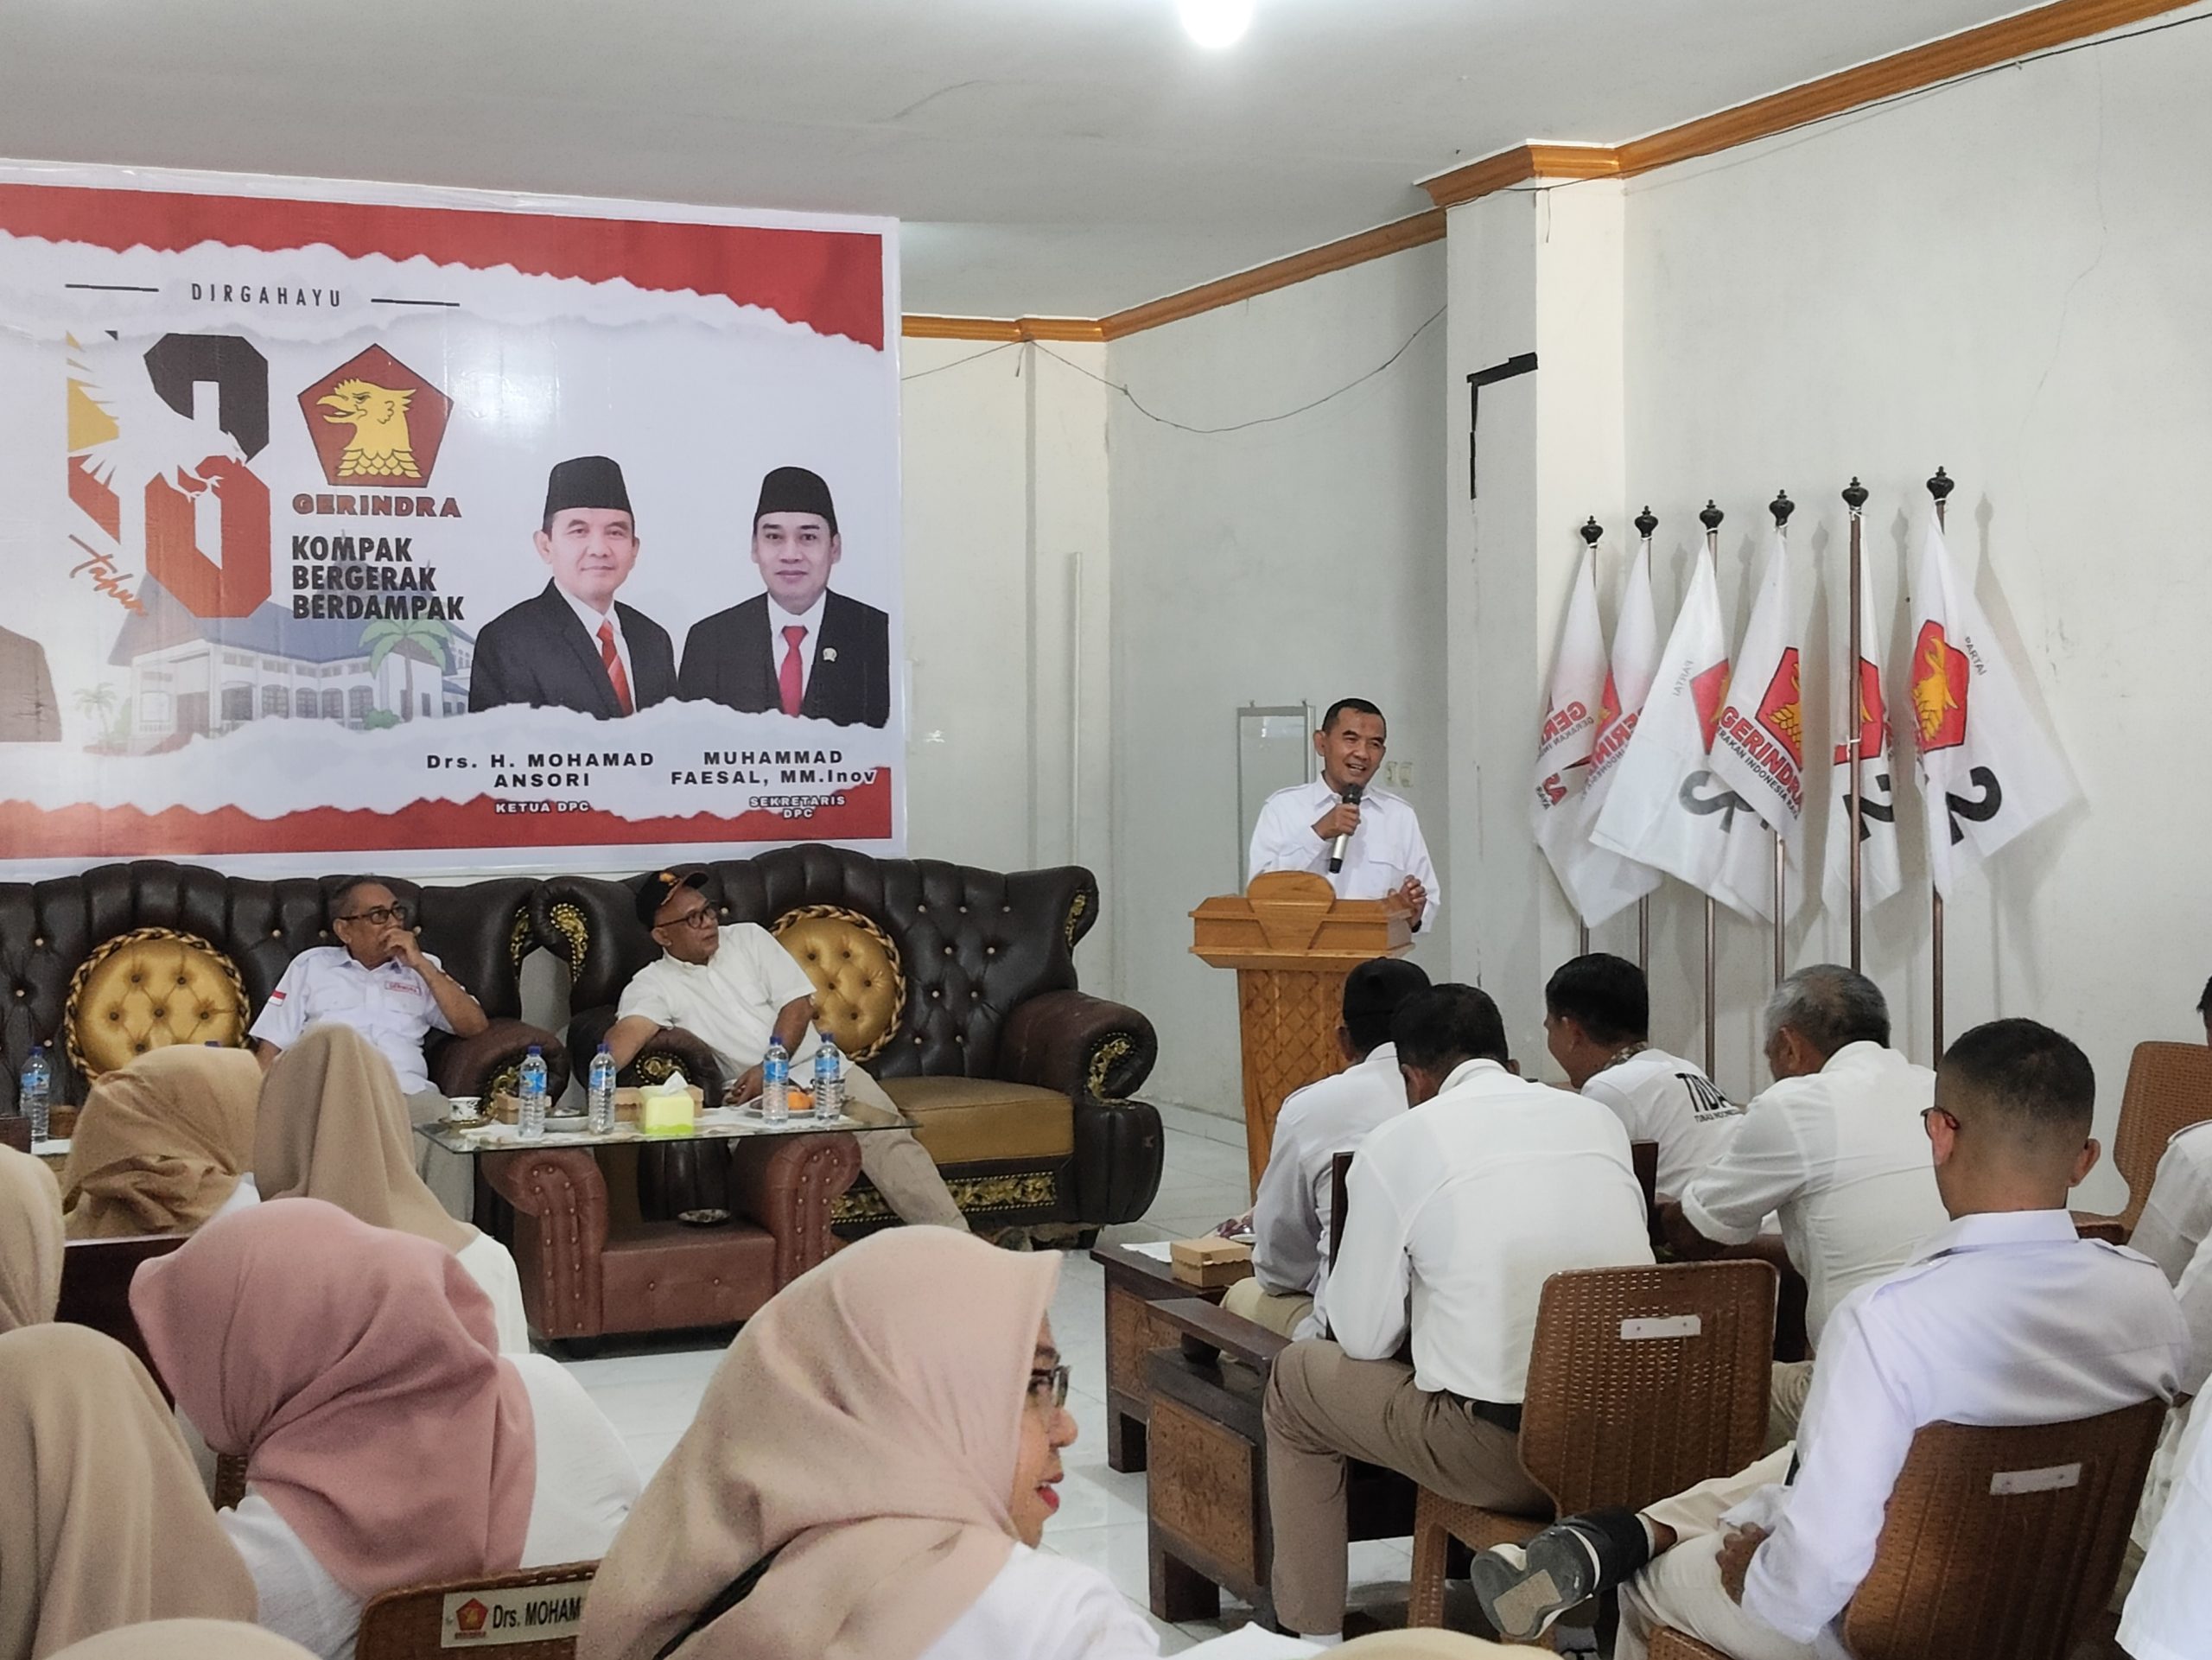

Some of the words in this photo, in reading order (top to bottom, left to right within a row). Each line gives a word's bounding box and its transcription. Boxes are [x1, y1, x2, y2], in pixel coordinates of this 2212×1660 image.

[192, 283, 341, 307] DIRGAHAYU
[292, 493, 462, 518] GERINDRA
[292, 536, 412, 562] KOMPAK
[292, 565, 436, 591] BERGERAK
[292, 594, 464, 620] BERDAMPAK
[1964, 636, 1986, 676] PARTAI
[426, 754, 478, 769] Drs.
[490, 753, 516, 768] H.
[528, 753, 655, 767] MOHAMAD
[703, 751, 843, 766] MUHAMMAD
[493, 773, 590, 788] ANSORI
[671, 771, 769, 786] FAESAL,
[780, 769, 875, 785] MM.Inov
[1745, 757, 1787, 802] INDONESIA
[495, 802, 550, 814] KETUA
[557, 800, 590, 813] DPC
[749, 795, 846, 808] SEKRETARIS
[783, 808, 813, 819] DPC
[1945, 766, 2002, 845] 2
[493, 1605, 520, 1628] Drs.
[524, 1597, 582, 1626] MOHAM
